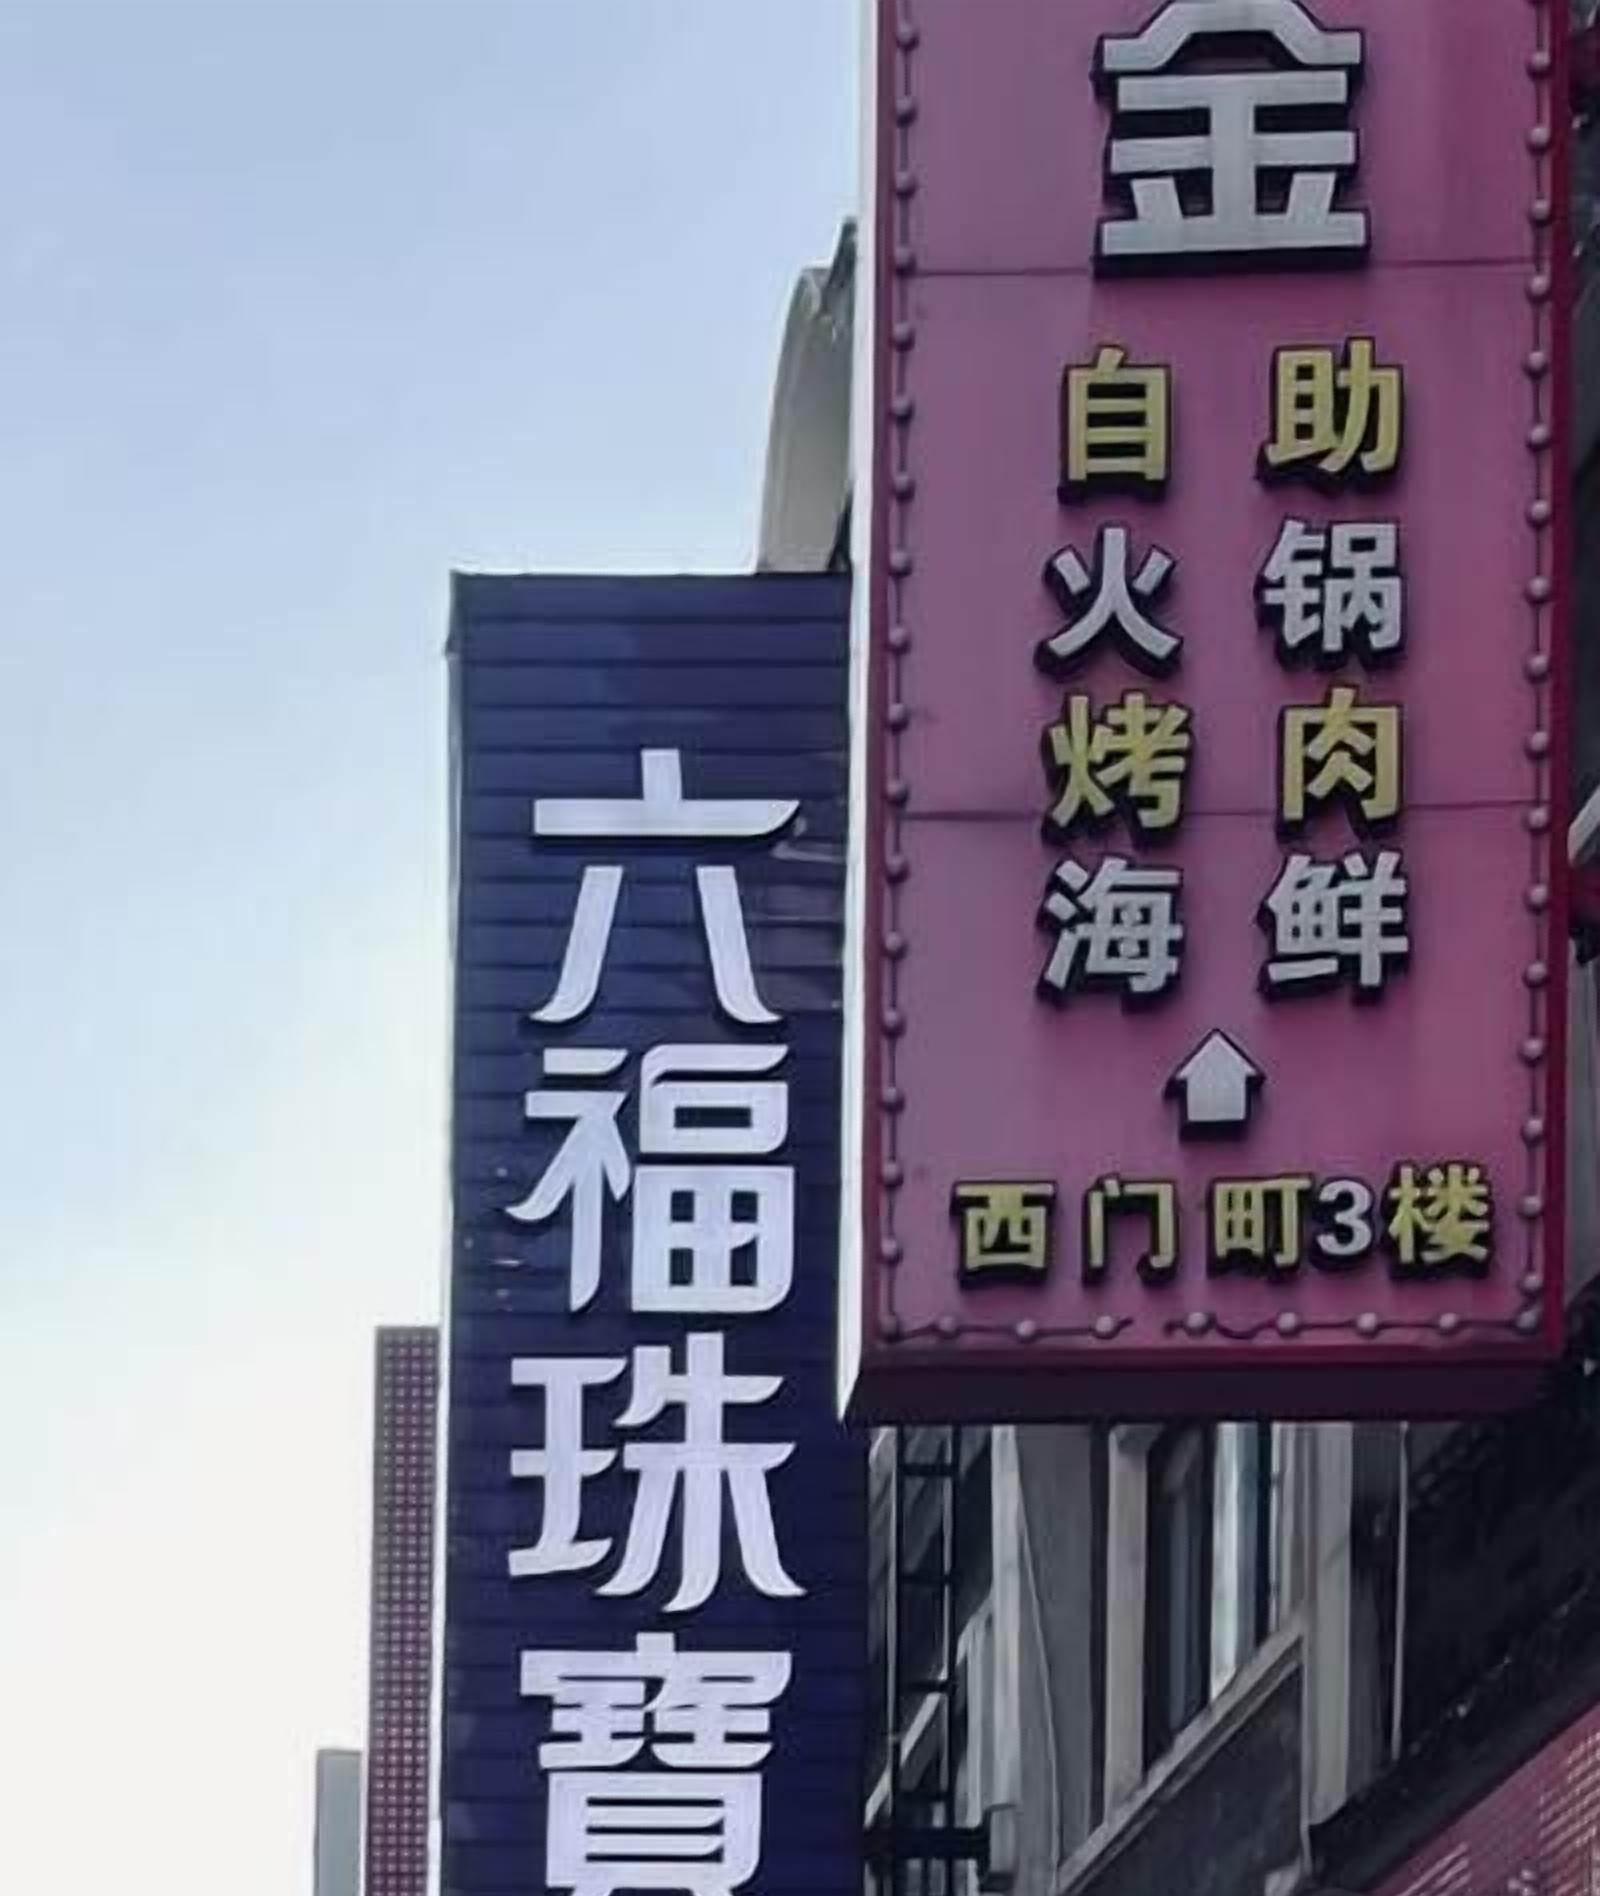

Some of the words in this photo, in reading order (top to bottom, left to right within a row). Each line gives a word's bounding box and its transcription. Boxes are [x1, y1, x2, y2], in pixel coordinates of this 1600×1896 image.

[1096, 0, 1369, 259] 金
[1063, 338, 1404, 484] 自助
[1047, 517, 1403, 662] 火锅
[1050, 684, 1399, 828] 烤肉
[1046, 850, 1410, 993] 海鲜
[953, 1161, 1492, 1274] 西门町3楼
